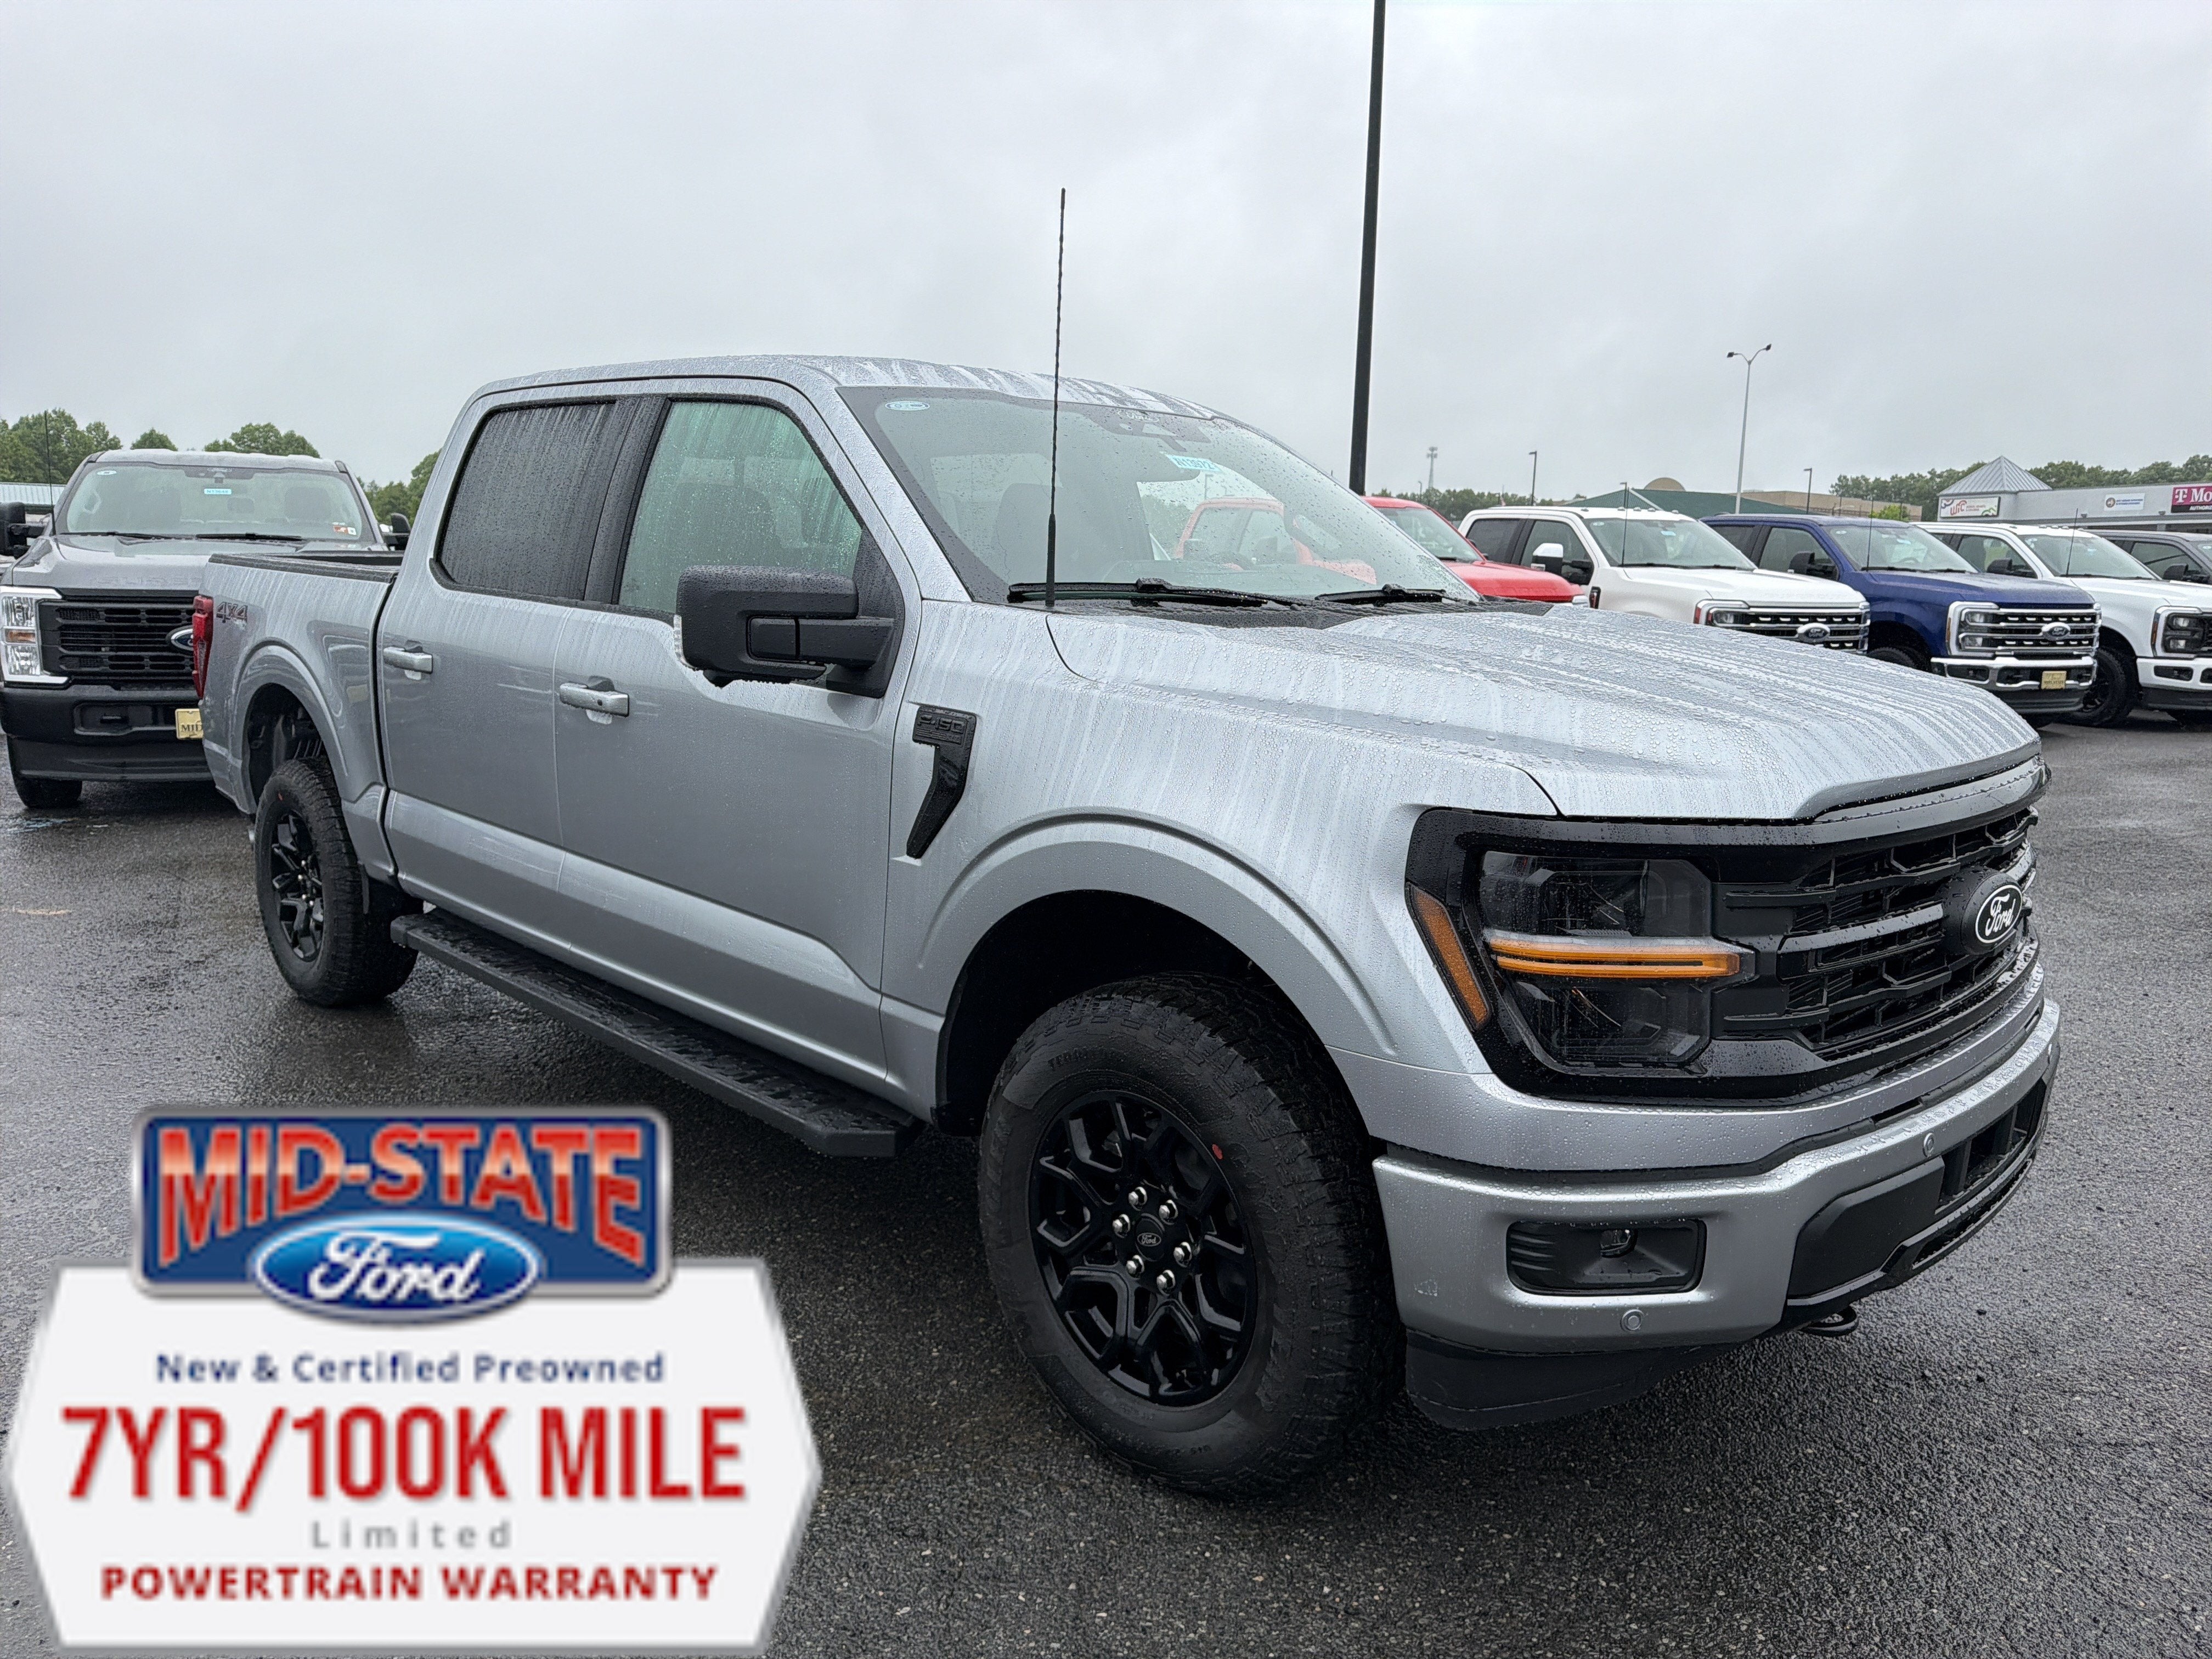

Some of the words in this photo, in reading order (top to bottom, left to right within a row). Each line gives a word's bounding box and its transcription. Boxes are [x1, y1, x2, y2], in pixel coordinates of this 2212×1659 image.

[918, 714, 964, 735] F-150
[1985, 893, 2016, 936] Ford
[1141, 1234, 1156, 1244] Ford
